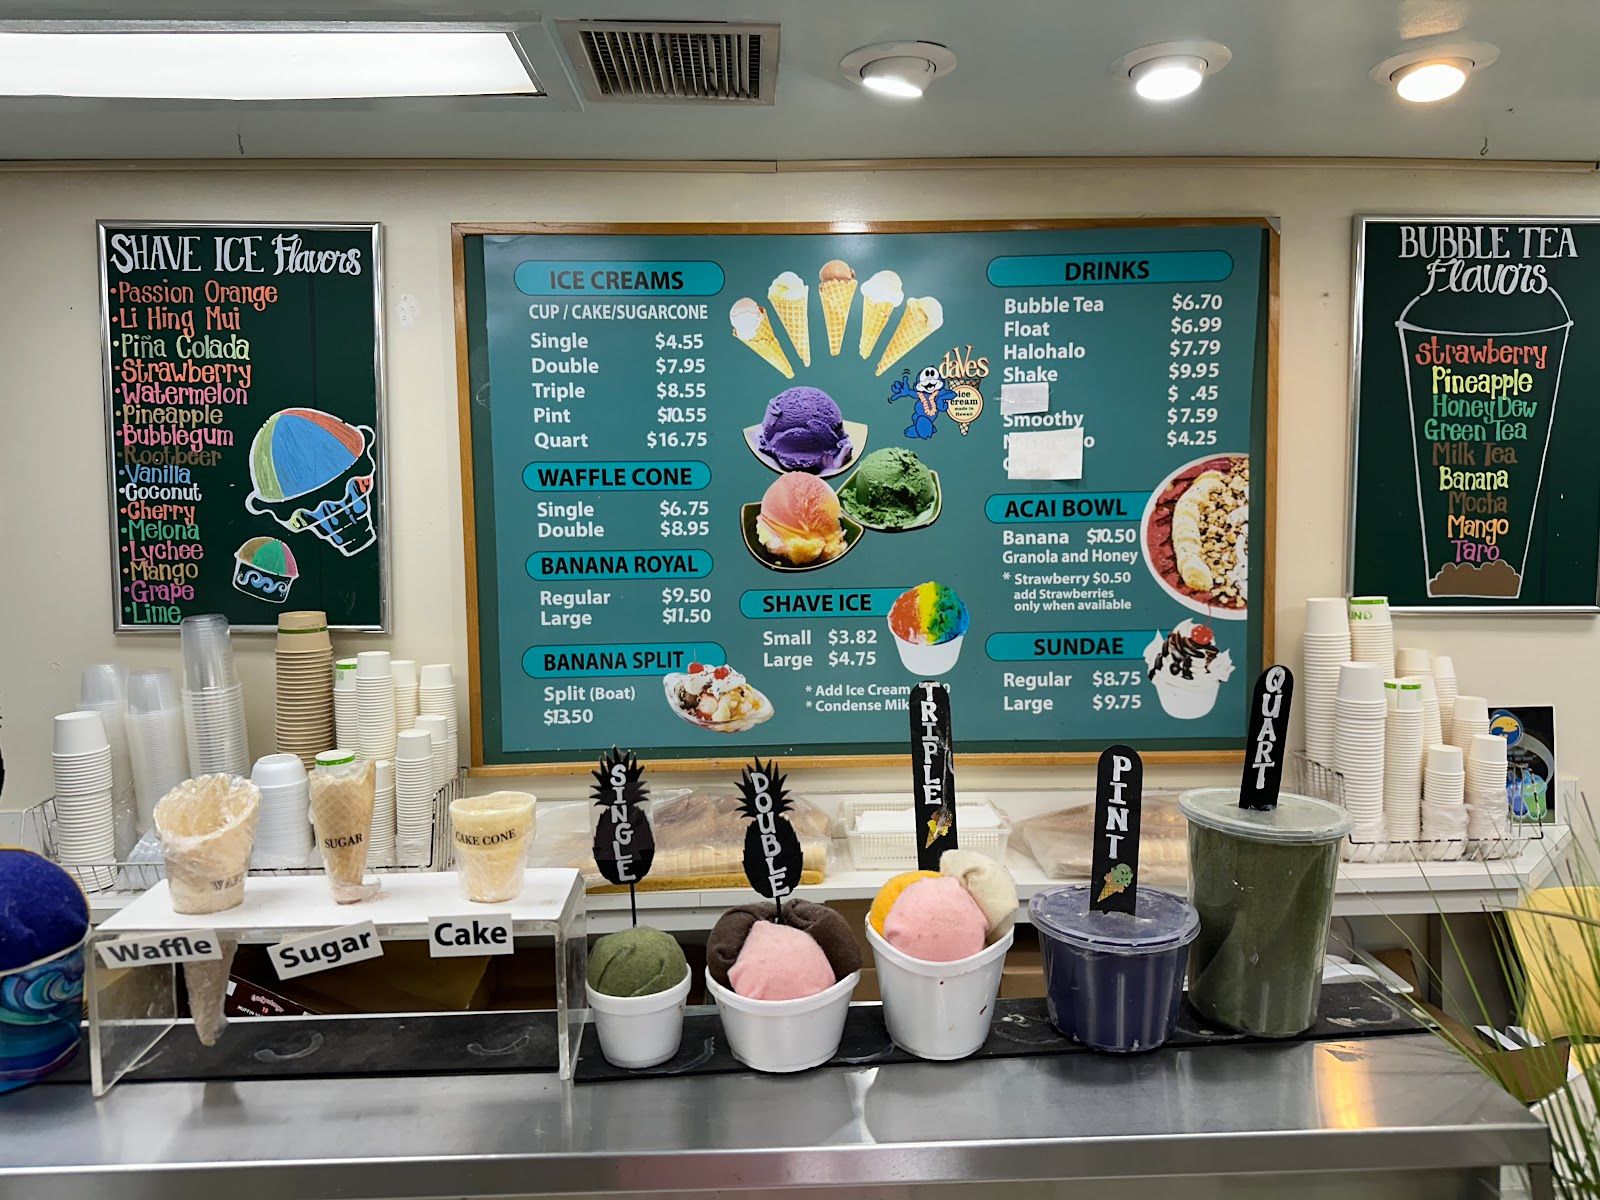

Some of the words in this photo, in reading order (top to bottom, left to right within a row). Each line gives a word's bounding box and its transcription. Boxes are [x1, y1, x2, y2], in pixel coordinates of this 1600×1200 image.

[1399, 226, 1510, 259] BUBBLE
[1518, 226, 1578, 258] TEA
[110, 233, 201, 273] SHAVE
[214, 235, 265, 273] ICE
[271, 233, 361, 276] Flavors
[550, 271, 585, 290] ICE
[591, 271, 684, 290] CREAMS
[1064, 260, 1150, 281] DRINKS
[1420, 259, 1549, 296] Flavors
[118, 279, 194, 304] Passion
[205, 280, 278, 311] Orange
[1004, 297, 1070, 315] Bubble
[1073, 296, 1104, 313] Tea
[1172, 293, 1222, 313] $6.70
[121, 307, 137, 329] Li
[148, 307, 195, 339] Hing
[206, 306, 241, 330] Mui
[528, 304, 559, 320] CUP
[1004, 320, 1050, 337] Float
[1171, 316, 1222, 335] $6.99
[122, 333, 167, 358] Piña
[177, 334, 250, 360] Colada
[531, 332, 588, 353] Single
[655, 332, 704, 350] $4.55
[1003, 342, 1086, 360] Halohalo
[1170, 339, 1221, 357] $7.79
[121, 359, 252, 388] Strawberry
[531, 357, 599, 374] Double
[656, 357, 705, 375] $7.95
[1003, 366, 1058, 383] Shake
[1168, 362, 1219, 380] $9.95
[532, 382, 585, 402] Triple
[656, 382, 706, 400] $8.55
[1432, 365, 1532, 399] Pineapple
[121, 382, 248, 405] Watermelon
[958, 390, 971, 398] ice
[123, 404, 224, 428] Pineapple
[534, 407, 571, 423] Pint
[1003, 410, 1084, 429] Smoothy
[1167, 407, 1218, 425] $7.59
[1433, 394, 1496, 423] Honey
[1498, 396, 1538, 418] Dew
[122, 423, 234, 452] Bubblegum
[534, 432, 589, 449] Quart
[647, 431, 708, 448] $16.75
[1166, 430, 1217, 448] $4.25
[1424, 418, 1486, 441] Green
[1489, 419, 1527, 441] Tea
[1432, 442, 1475, 466] Milk
[1482, 442, 1518, 467] Tea
[125, 464, 191, 485] Vanilla
[537, 468, 626, 487] WAFFLE
[631, 468, 692, 486] CONE
[1439, 465, 1509, 491] Banana
[125, 483, 202, 501] Coconut
[127, 501, 195, 526] Cherry
[537, 501, 595, 521] Single
[659, 500, 709, 517] $6.75
[1004, 500, 1056, 518] ACAI
[1062, 499, 1127, 517] BOWL
[1448, 492, 1507, 514] Mocha
[129, 520, 200, 541] Melona
[537, 522, 605, 538] Double
[660, 520, 709, 537] $8.95
[1003, 530, 1069, 545] Banana
[1447, 514, 1509, 545] Mango
[130, 541, 204, 568] Lychee
[1003, 550, 1058, 564] Granola
[1061, 549, 1088, 563] and
[1092, 549, 1138, 565] Honey
[1450, 539, 1500, 563] Taro
[130, 561, 199, 586] Mango
[541, 556, 629, 575] BANANA
[634, 555, 698, 573] ROYAL
[1014, 572, 1090, 587] Strawberry
[1092, 571, 1131, 586] $0.50
[131, 580, 195, 604] Grape
[540, 589, 611, 609] Regular
[662, 587, 711, 604] $9.50
[1014, 589, 1037, 600] add
[1039, 588, 1114, 600] Strawberries
[763, 595, 833, 613] SHAVE
[839, 594, 872, 612] ICE
[1014, 600, 1040, 613] only
[1043, 600, 1074, 611] when
[1077, 599, 1132, 611] available
[132, 605, 182, 624] Lime
[540, 611, 592, 629] Large
[763, 630, 811, 646] Small
[828, 629, 877, 646] $3.82
[1033, 638, 1124, 656] SUNDAE
[544, 652, 627, 672] BANANA
[633, 651, 684, 669] SPLIT
[763, 652, 814, 670] Large
[828, 650, 876, 667] $4.75
[815, 684, 843, 697] Add
[846, 684, 866, 696] Ice
[868, 684, 911, 696] Cream
[1003, 671, 1072, 691] Regular
[1092, 671, 1141, 688] $8.75
[543, 686, 586, 704] Split
[590, 686, 636, 702] (Boat)
[815, 699, 882, 712] Condense
[1003, 696, 1053, 714] Large
[1092, 694, 1141, 712] $9.75
[1252, 665, 1285, 790] QUART
[918, 682, 942, 805] TRIPLE
[1105, 755, 1132, 860] PINT
[610, 764, 636, 882] SINGLE
[324, 833, 363, 849] SUGAR
[455, 831, 480, 846] CAKE
[482, 828, 516, 846] CONE
[751, 772, 789, 898] DOUBLE
[434, 920, 508, 947] Cake
[107, 936, 213, 964] Waffle
[279, 930, 372, 969] Sugar
